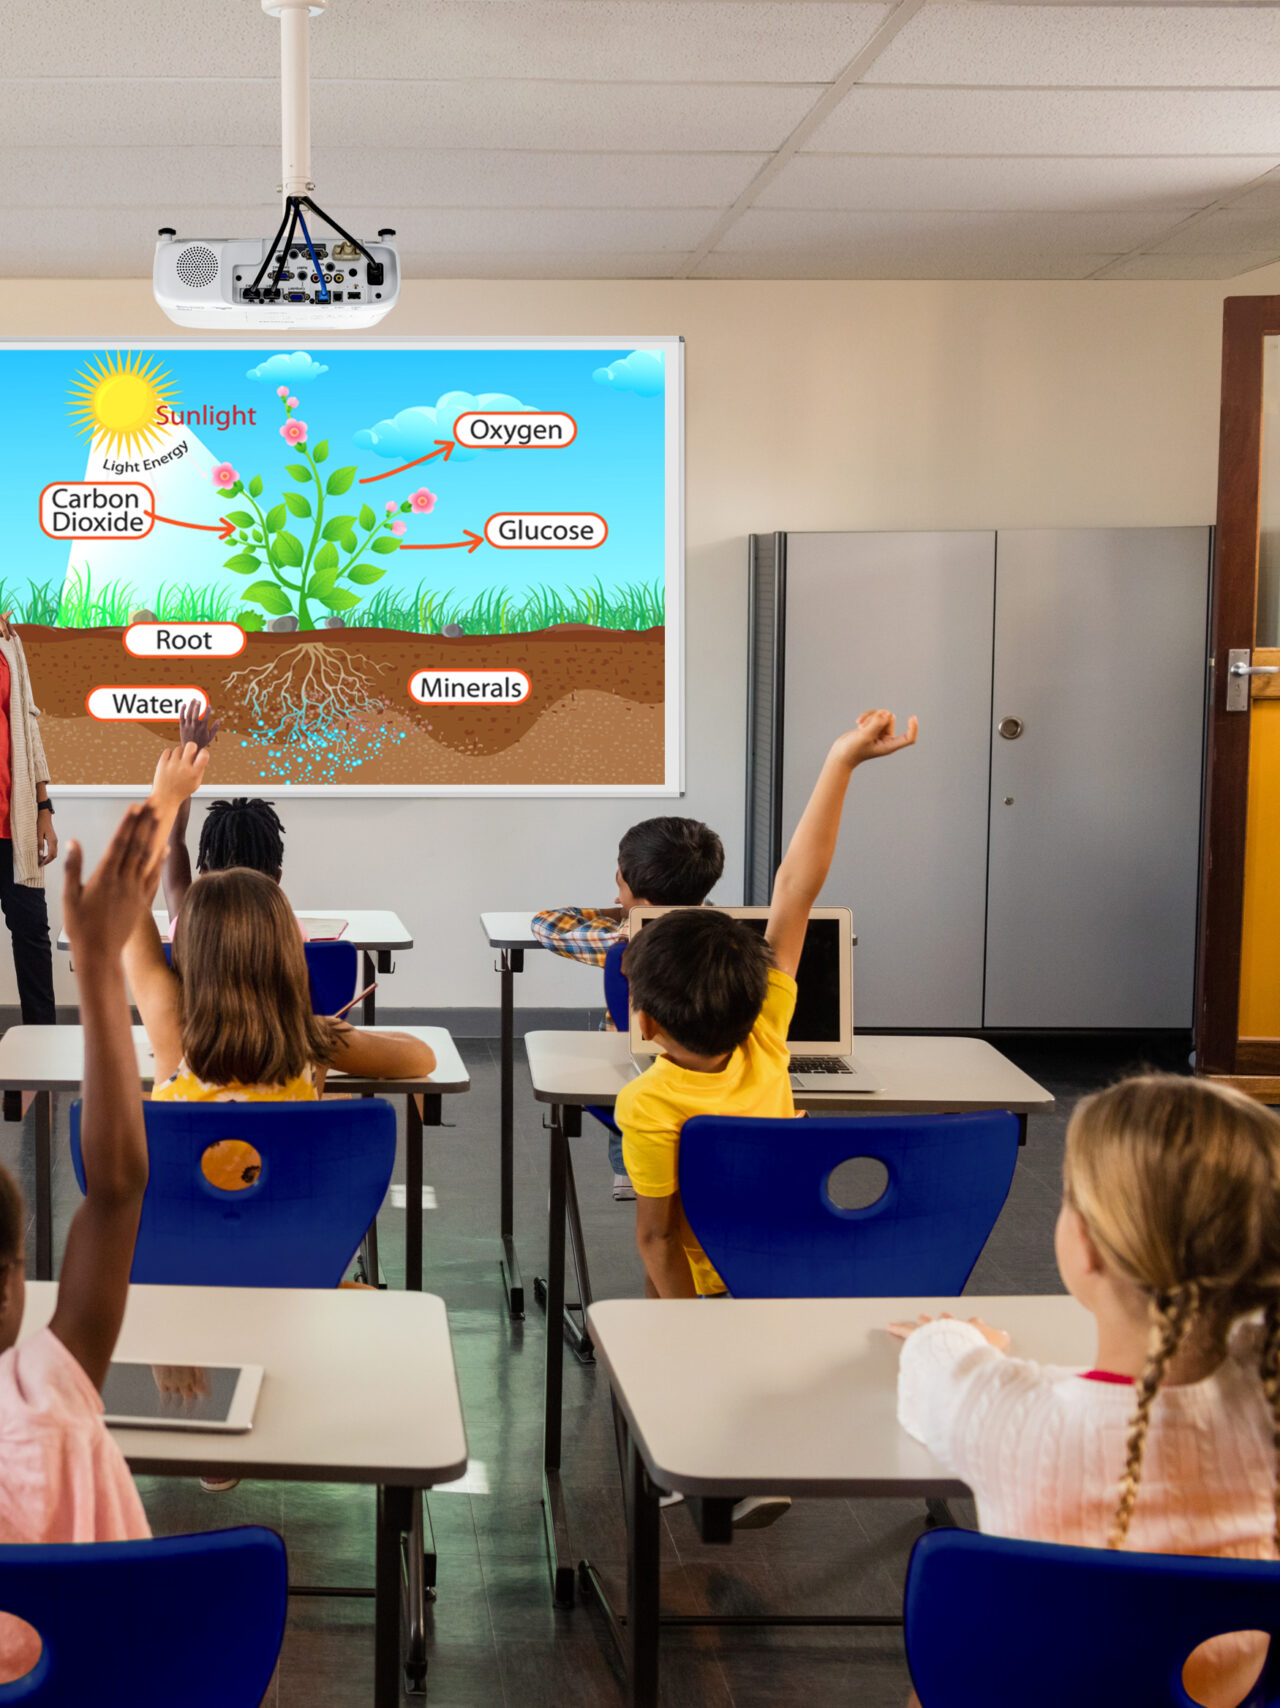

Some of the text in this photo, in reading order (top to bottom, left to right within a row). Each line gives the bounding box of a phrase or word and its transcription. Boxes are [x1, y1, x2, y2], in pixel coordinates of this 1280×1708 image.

[156, 404, 257, 431] Sunlight
[470, 419, 564, 445] Oxygen
[102, 440, 189, 475] Light Energy
[52, 487, 139, 509] Carbon
[52, 511, 144, 533] Dioxide
[498, 519, 594, 542] Glucose
[157, 629, 213, 650] Root
[422, 676, 521, 698] Minerals
[112, 694, 183, 714] Water
